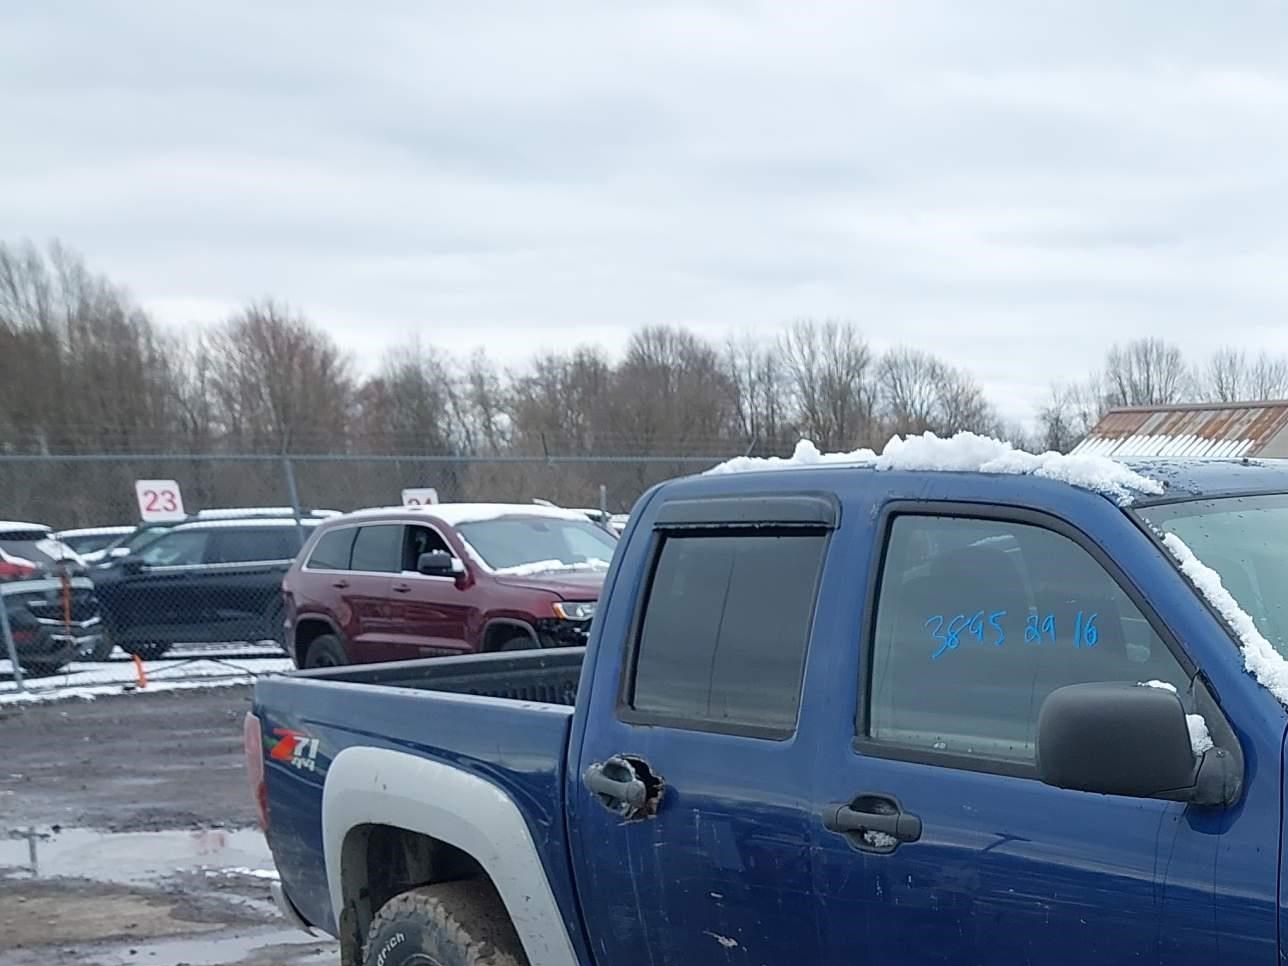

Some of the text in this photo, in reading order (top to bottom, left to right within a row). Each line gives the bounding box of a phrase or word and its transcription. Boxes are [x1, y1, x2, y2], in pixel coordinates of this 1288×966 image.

[143, 489, 178, 512] 23
[923, 610, 1099, 661] 3895 29 16
